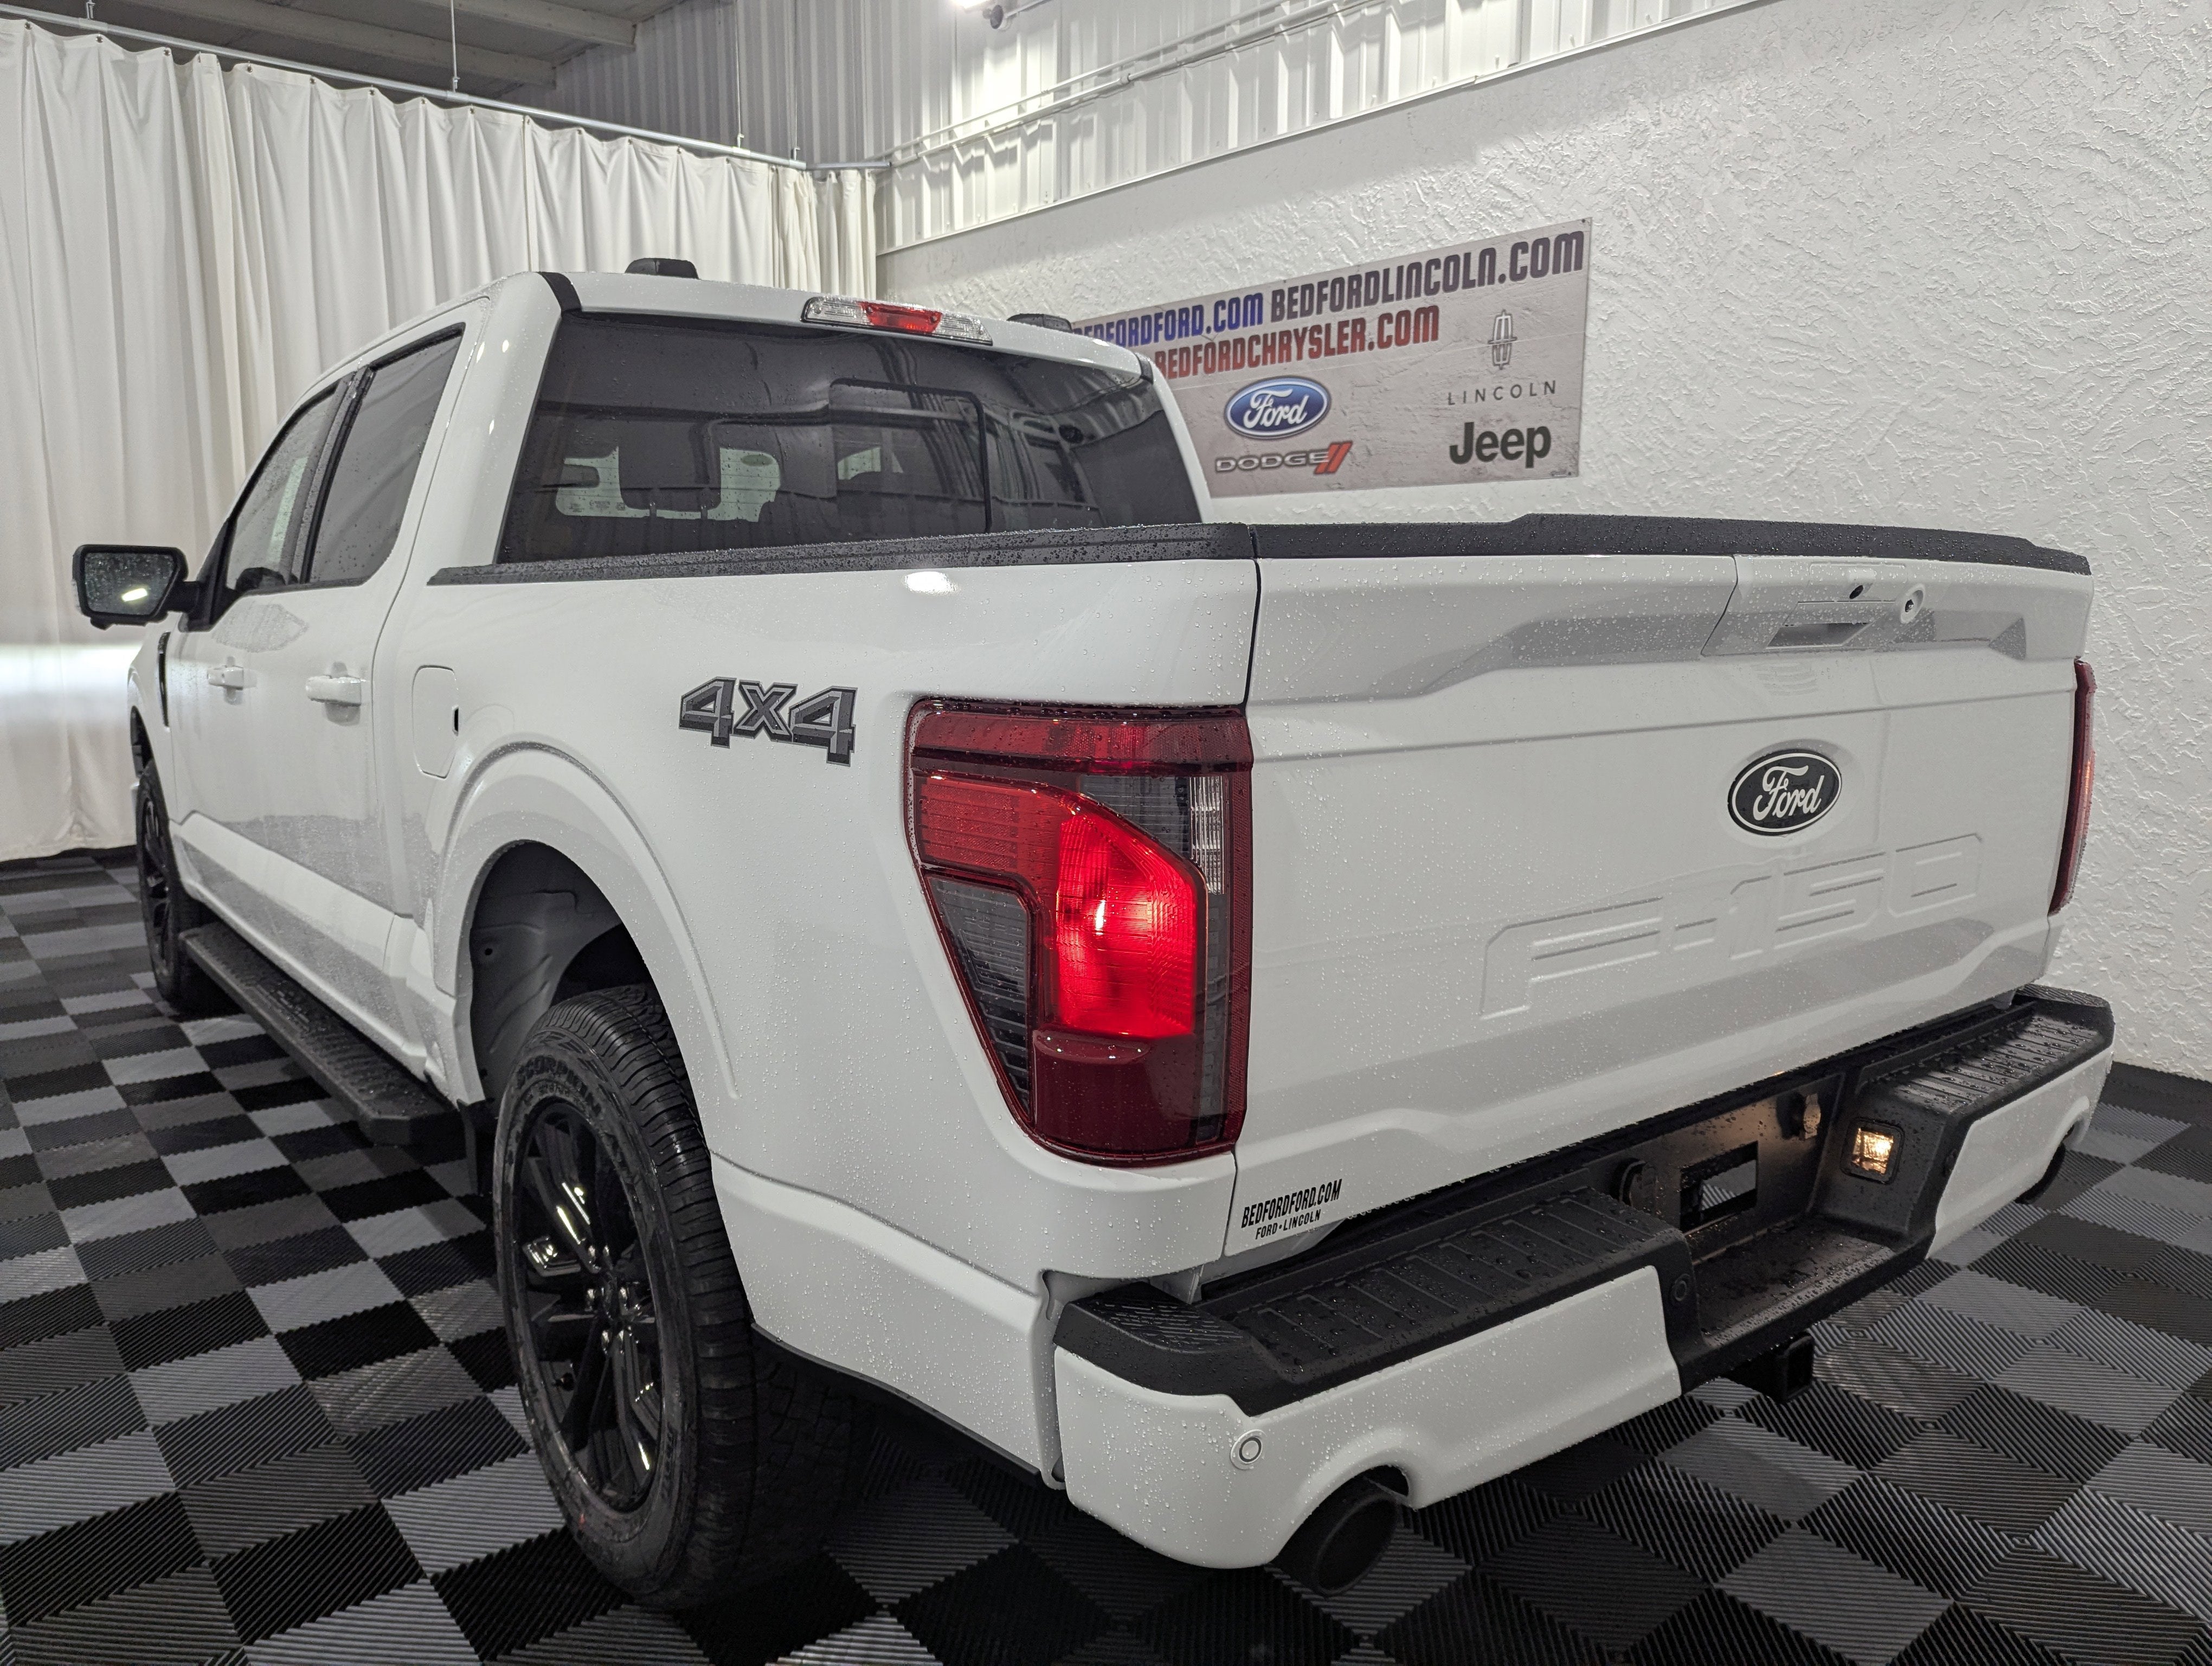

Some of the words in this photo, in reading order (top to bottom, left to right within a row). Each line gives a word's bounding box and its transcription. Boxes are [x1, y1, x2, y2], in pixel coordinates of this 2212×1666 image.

[1072, 292, 1263, 348] DFORDFORD.COM
[1270, 230, 1584, 323] BEDFORDLINCOLN.COM
[1155, 305, 1439, 379] BEDFORDCHRYSLER.COM
[1243, 388, 1309, 428] Ford
[1448, 380, 1555, 405] LINCOLN
[1215, 448, 1330, 473] DODGE
[1449, 421, 1551, 469] Jeep
[1753, 765, 1825, 821] Ford
[1241, 1178, 1342, 1228] BEDFORDFORD.COM
